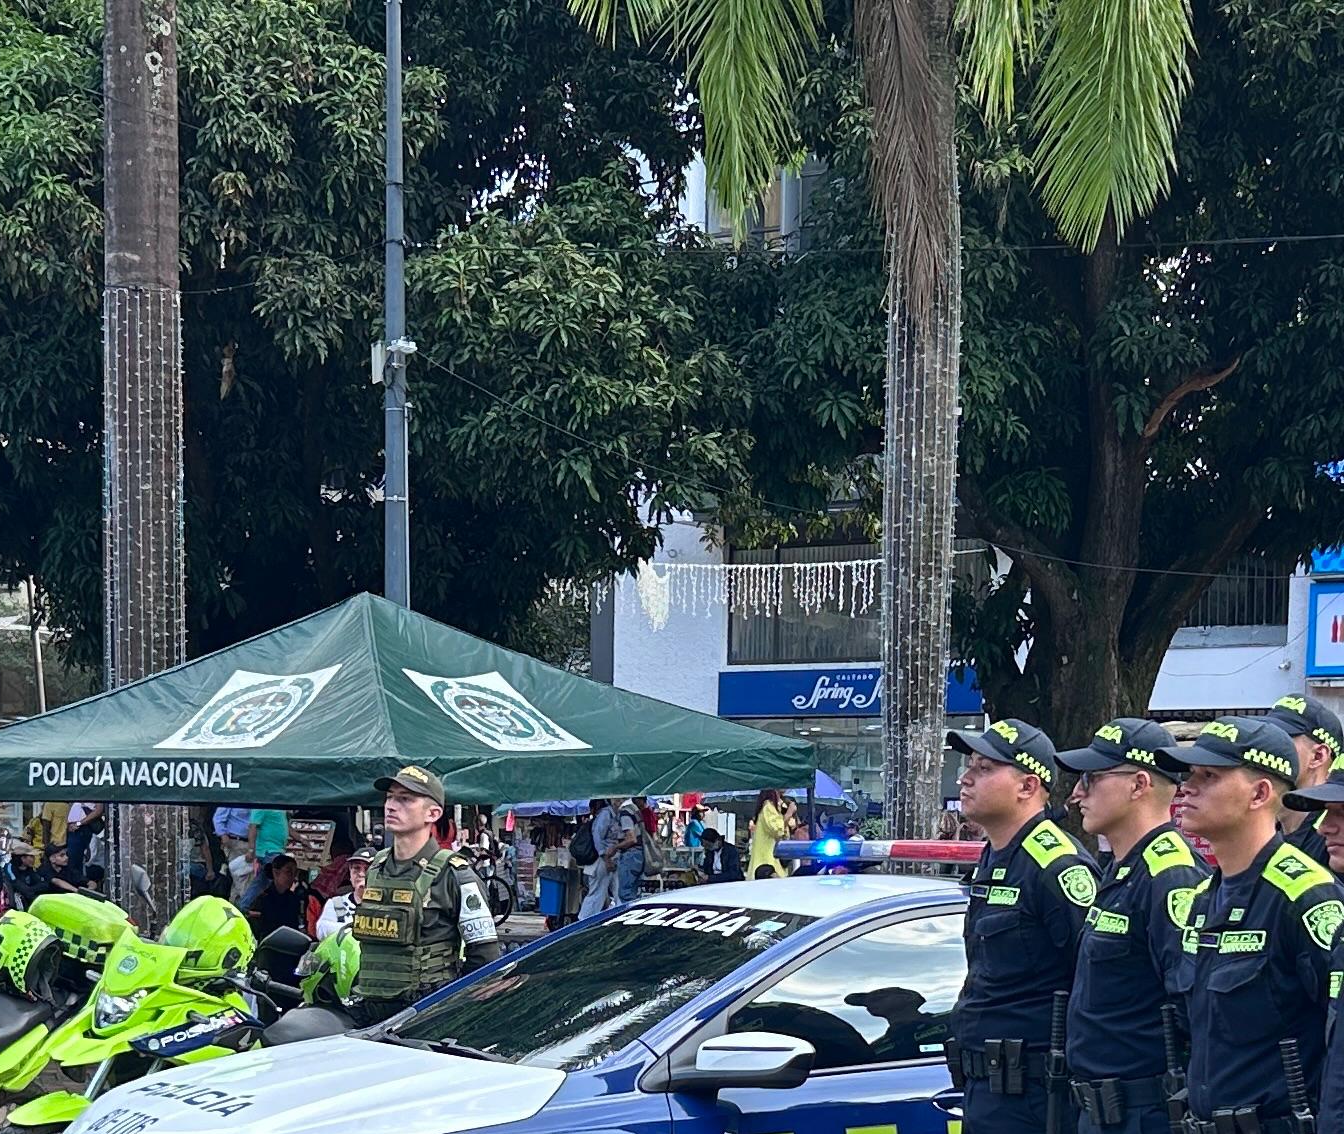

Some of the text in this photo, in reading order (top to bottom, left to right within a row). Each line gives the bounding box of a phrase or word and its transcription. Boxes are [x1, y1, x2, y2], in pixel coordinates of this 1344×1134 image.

[792, 675, 854, 709] Spring
[28, 755, 240, 788] POLICÍA NACIONAL
[603, 907, 751, 937] POLICÍA
